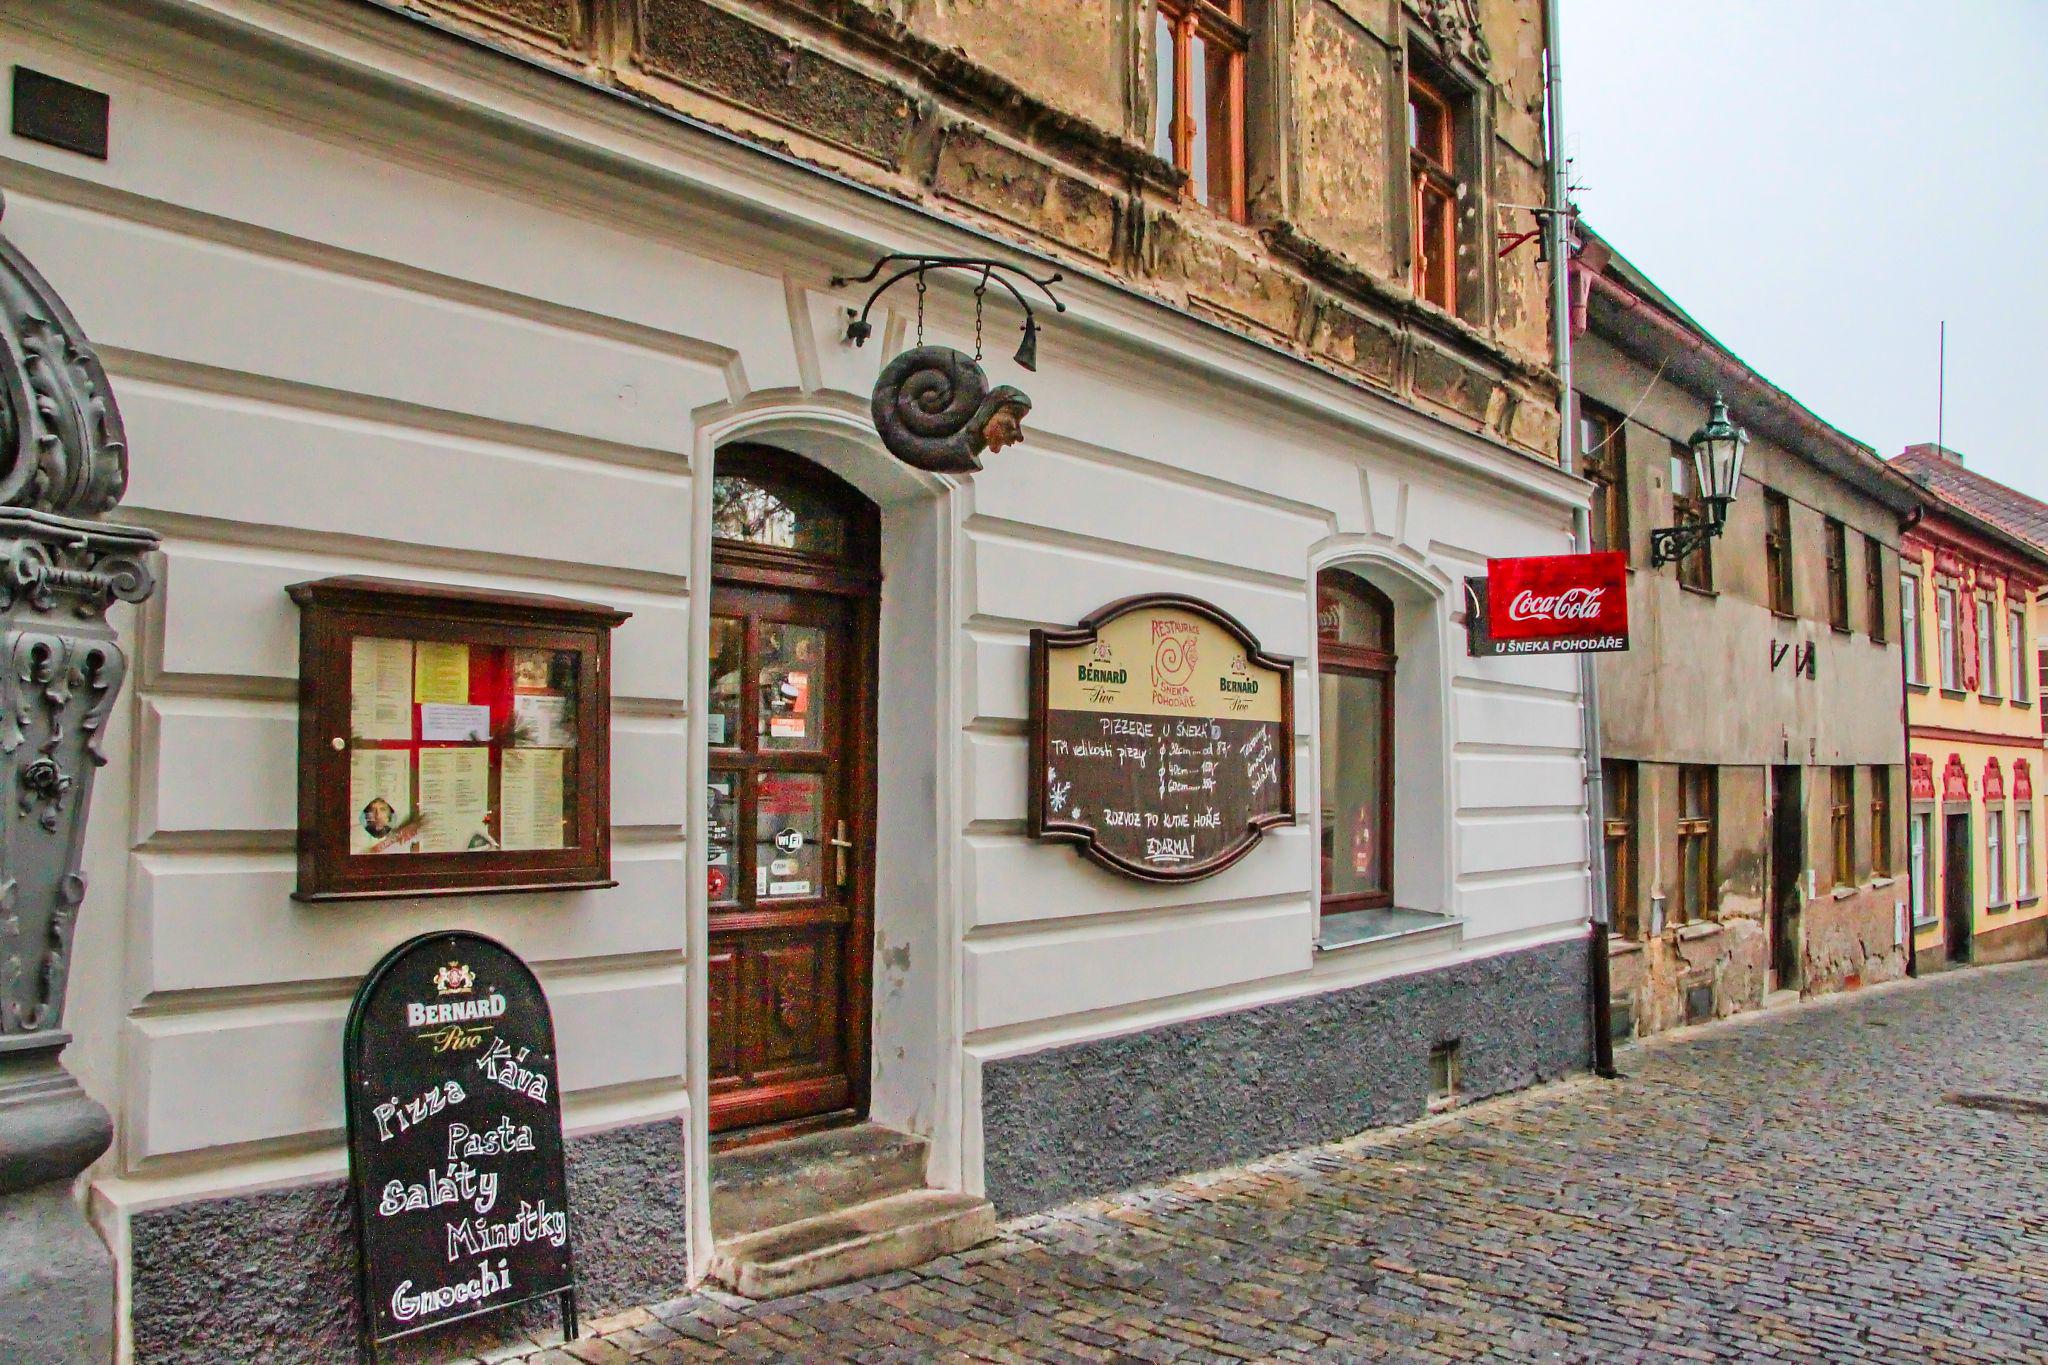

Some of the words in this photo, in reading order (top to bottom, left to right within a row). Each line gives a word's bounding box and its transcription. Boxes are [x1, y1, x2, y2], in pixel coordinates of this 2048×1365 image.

[1509, 588, 1606, 621] Coca-Cola
[1496, 642, 1506, 653] U
[1508, 640, 1550, 652] ŠNEKA
[1552, 636, 1623, 651] POHODÁŘE
[1078, 665, 1127, 684] BERNARD
[1220, 678, 1258, 694] BERNARD
[1073, 739, 1113, 757] velikosti
[1103, 809, 1141, 827] ROZVOZ
[1144, 813, 1158, 828] PO
[1146, 835, 1195, 855] ZDARMA!
[407, 994, 506, 1027] BERNARD
[433, 1025, 481, 1053] Pivo
[476, 1036, 547, 1103] Káva
[373, 1080, 466, 1142] Pizza
[448, 1115, 535, 1159] Pasta
[379, 1161, 498, 1216] Saláty
[447, 1200, 566, 1262] Minutky
[392, 1258, 512, 1321] Gnocchi
